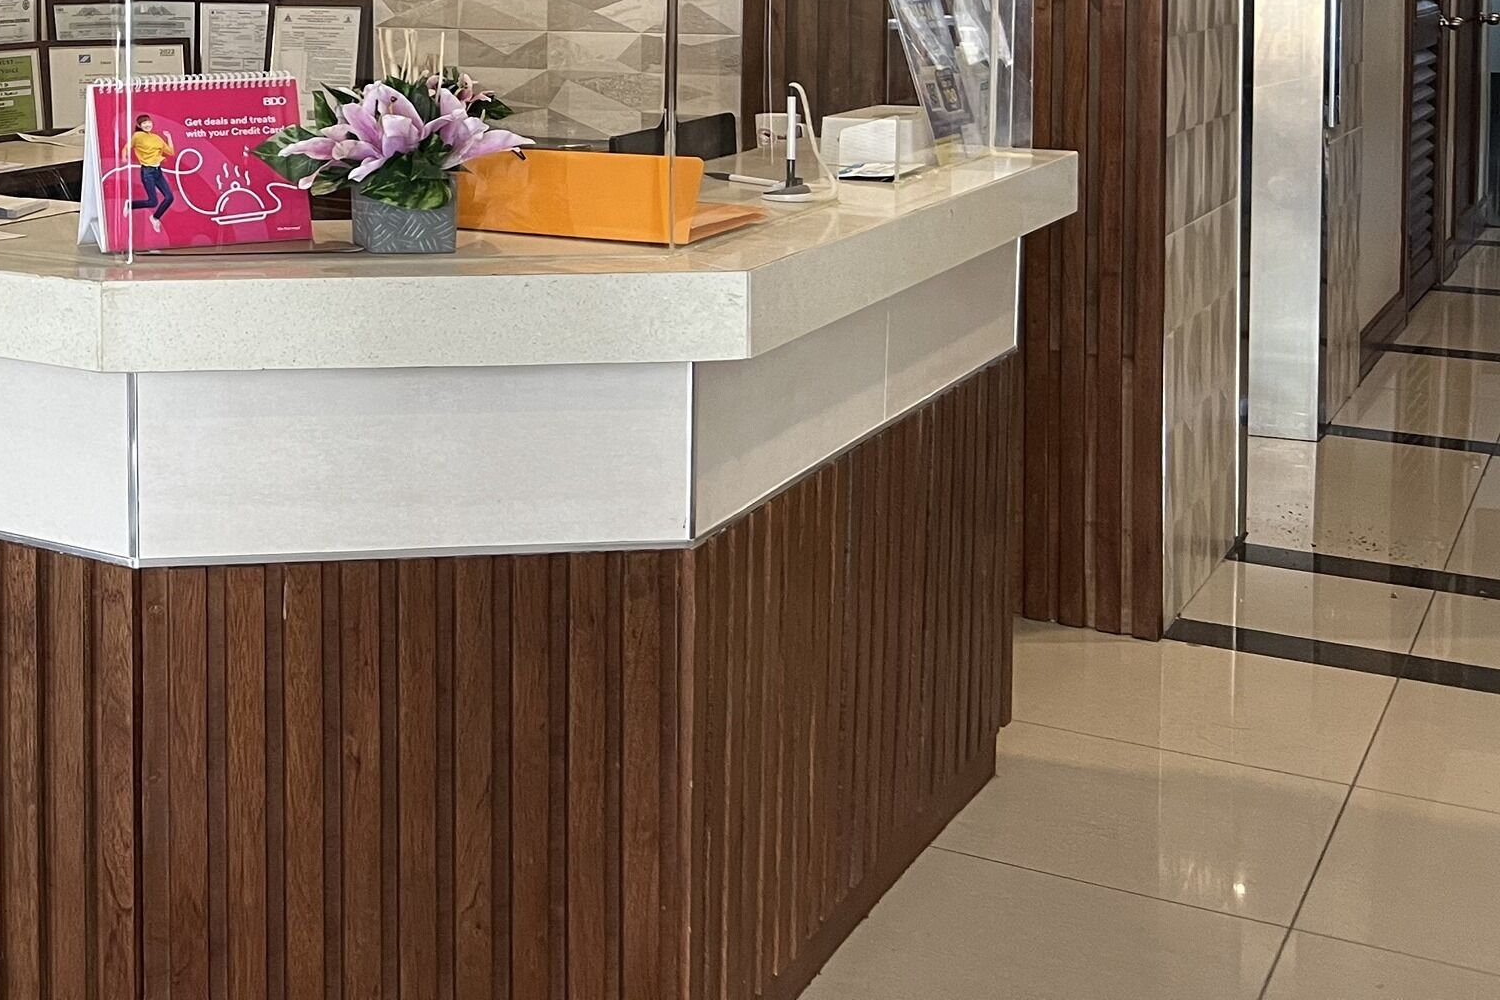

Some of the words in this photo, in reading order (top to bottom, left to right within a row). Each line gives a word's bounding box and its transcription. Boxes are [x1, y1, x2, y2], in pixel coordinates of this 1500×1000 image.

[262, 96, 286, 105] BDO
[185, 118, 202, 127] Get
[204, 117, 228, 126] deals
[230, 116, 248, 125] and
[249, 115, 277, 124] treats
[186, 128, 207, 138] with
[208, 129, 230, 138] your
[231, 126, 261, 136] Credit
